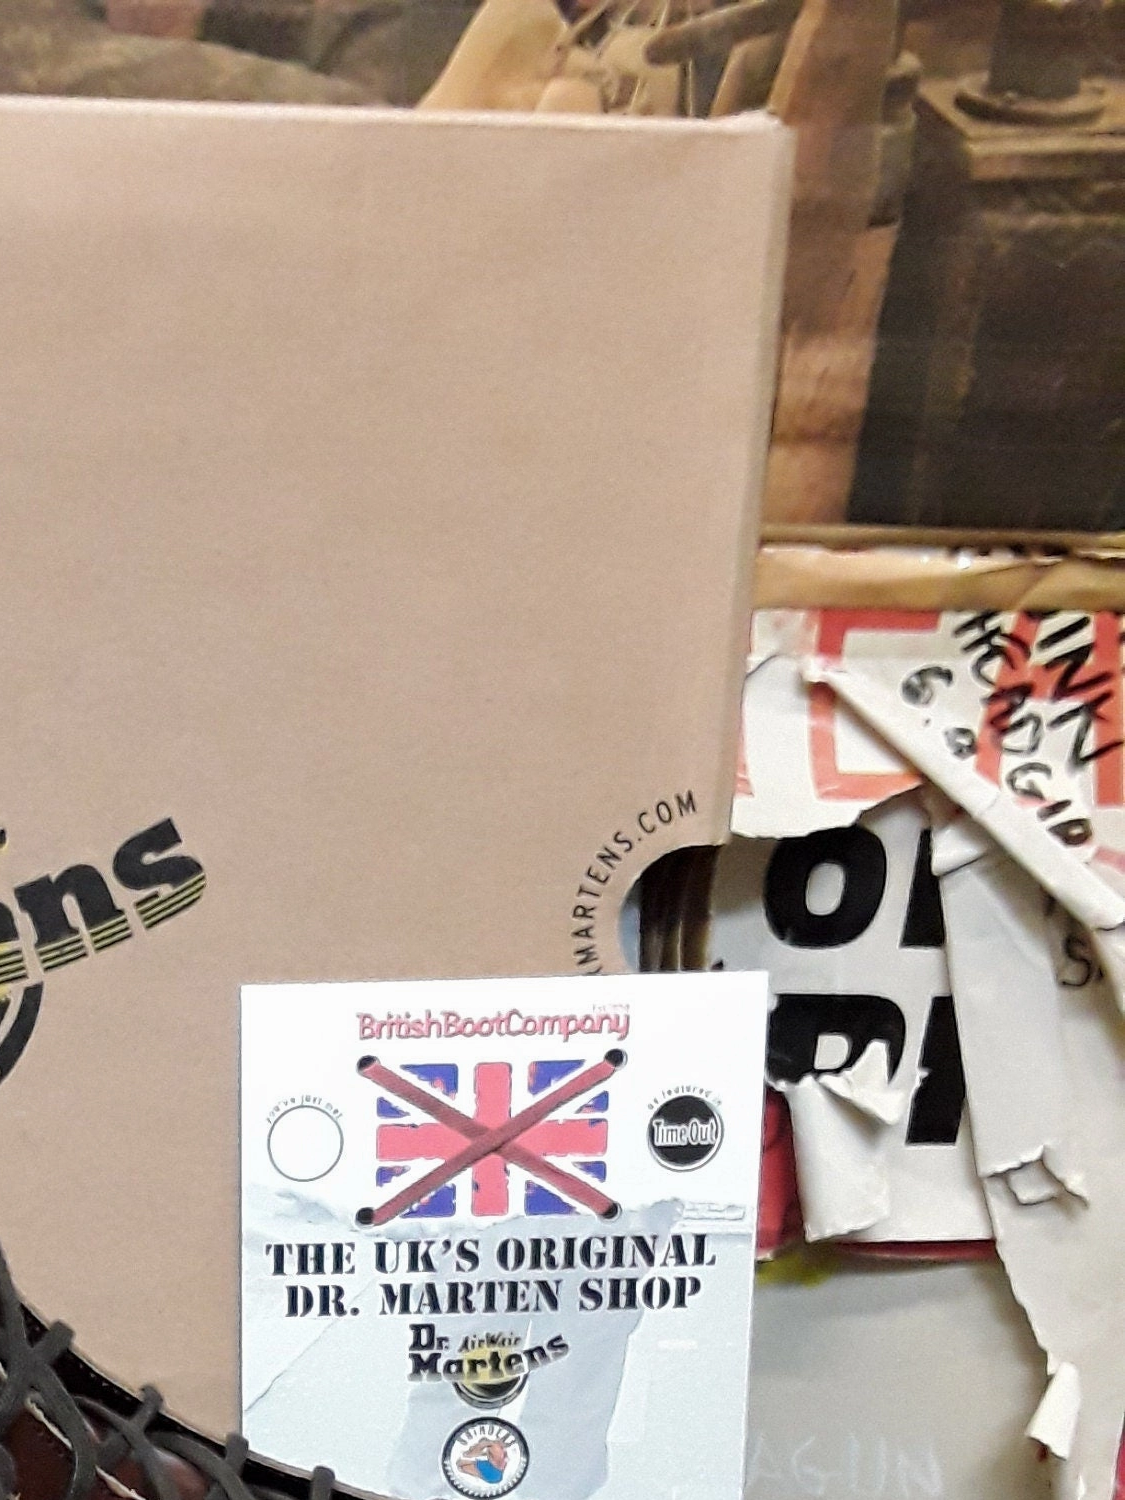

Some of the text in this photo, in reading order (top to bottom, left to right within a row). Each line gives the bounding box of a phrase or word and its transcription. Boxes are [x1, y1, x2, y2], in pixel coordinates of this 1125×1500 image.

[653, 1117, 718, 1145] Time Out
[265, 1234, 716, 1275] THE UK'S ORIGINAL
[284, 1276, 702, 1317] DR. MARTEN SHOP
[408, 1323, 450, 1350] Dr.
[407, 1334, 570, 1381] Martens
